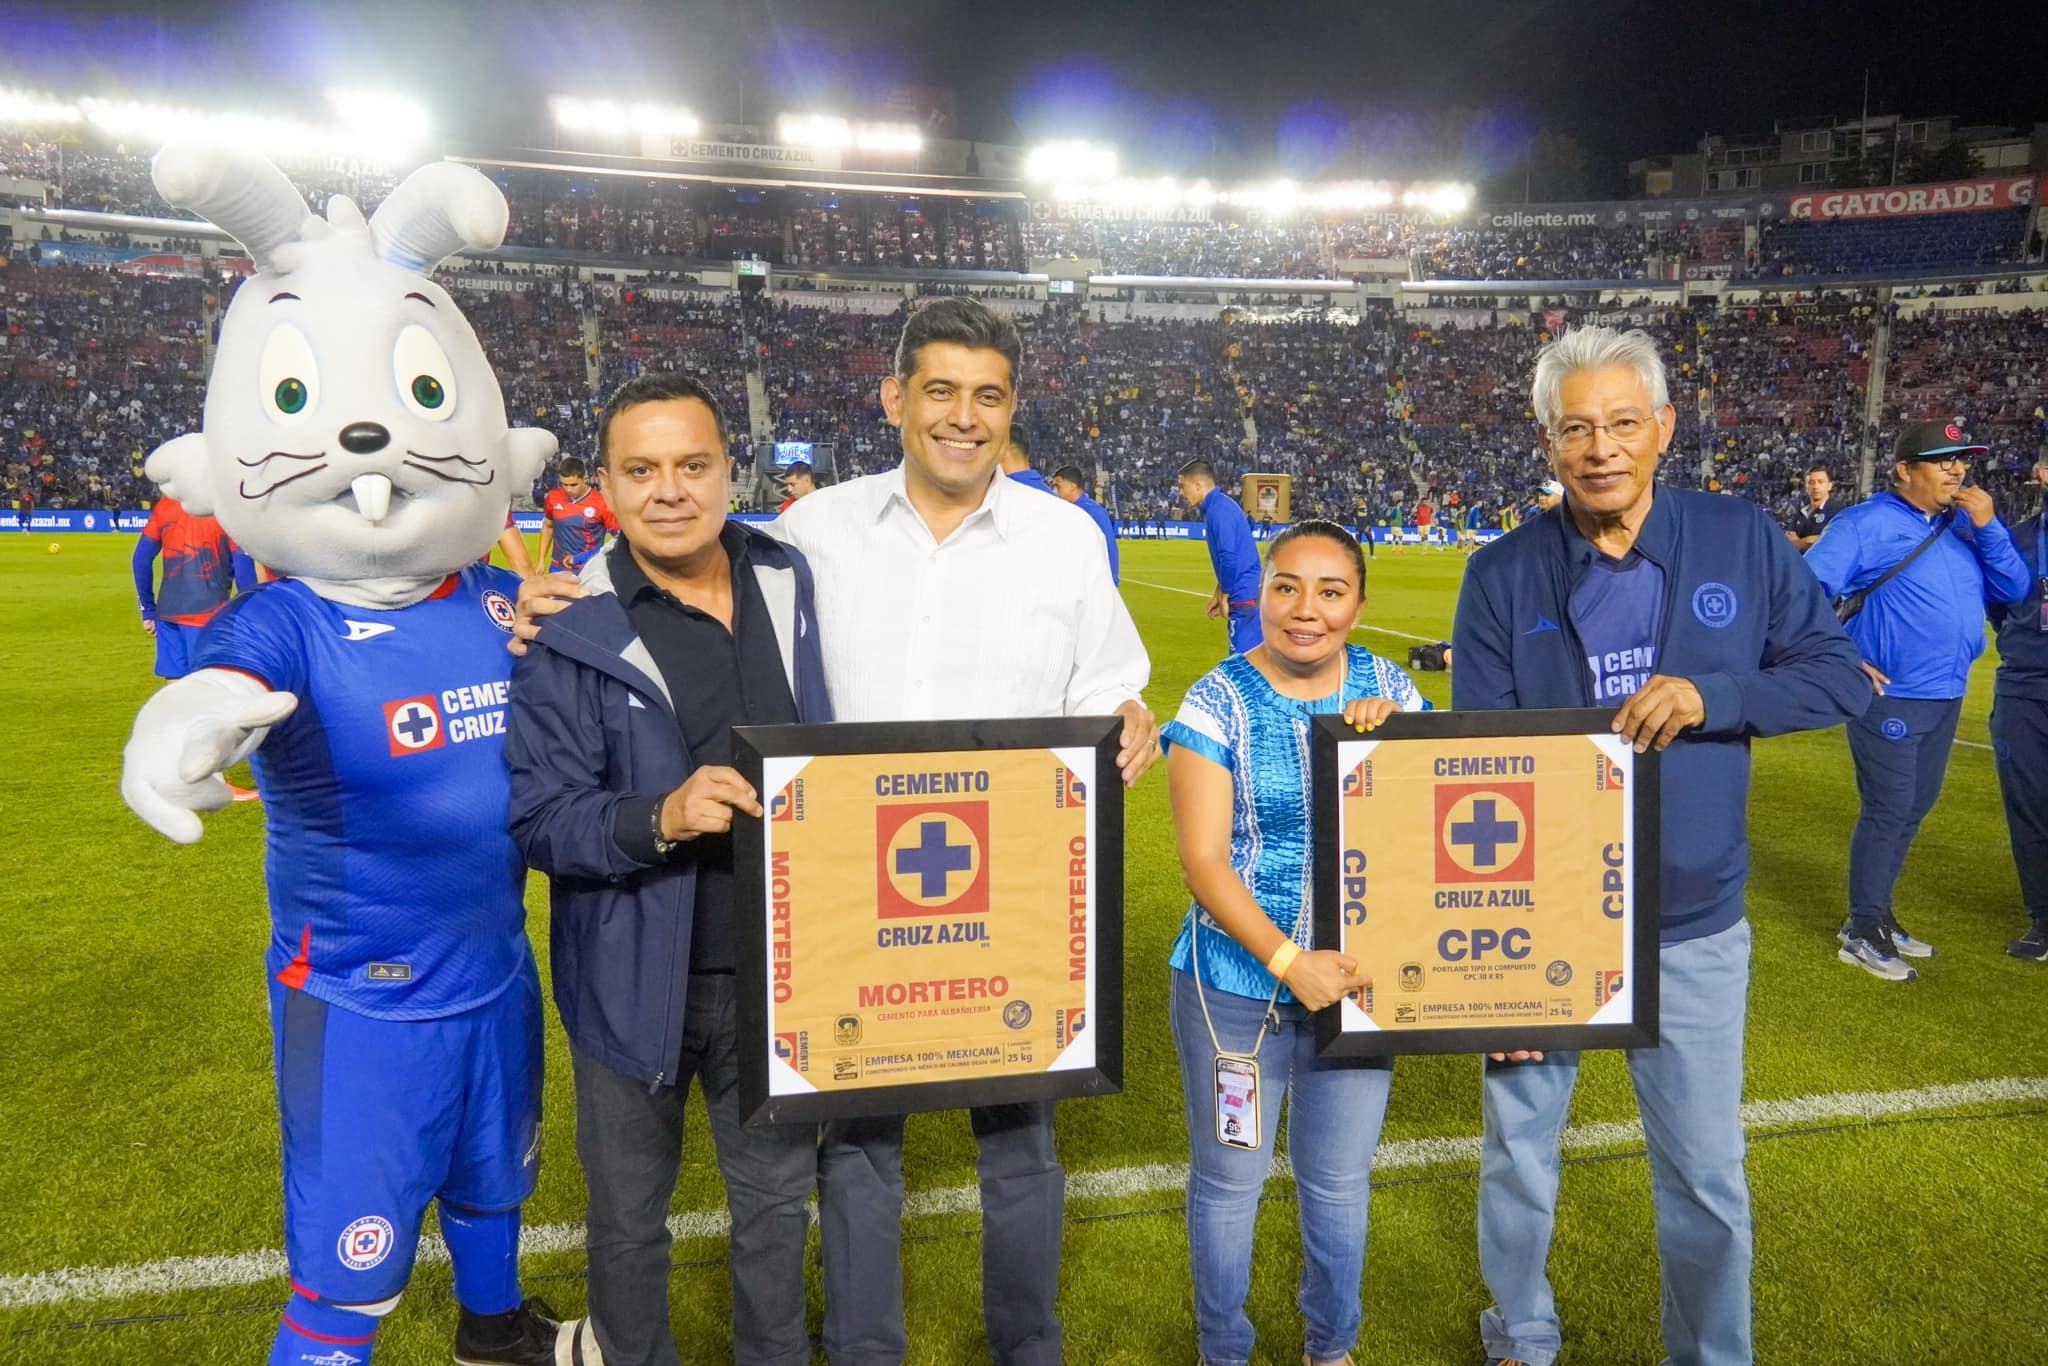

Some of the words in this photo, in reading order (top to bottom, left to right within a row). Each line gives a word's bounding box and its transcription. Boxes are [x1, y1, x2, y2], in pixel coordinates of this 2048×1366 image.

[690, 142, 750, 160] CEMENTO
[752, 147, 783, 161] CRUZ
[785, 149, 815, 163] AZUL
[1821, 183, 1996, 217] GATORADE
[1492, 211, 1597, 228] caliente.mx
[457, 278, 512, 292] CEMENTO
[1604, 646, 1656, 673] CEM
[448, 710, 507, 744] CRUZ
[1364, 759, 1373, 797] CEMENTO
[1434, 755, 1535, 777] CEMENTO
[1596, 753, 1604, 791] CEMENTO
[875, 770, 989, 797] CEMENTO
[1055, 767, 1064, 809] CEMENTO
[795, 778, 804, 822] CEMENTO
[1344, 848, 1367, 926] CPC
[1602, 842, 1624, 920] CPC
[1069, 835, 1087, 982] MORTERO
[1434, 890, 1484, 909] CRUZ
[1487, 889, 1535, 907] AZUL
[771, 851, 793, 1004] MORTERO
[877, 925, 933, 948] CRUZ
[936, 921, 990, 944] AZUL
[1437, 927, 1532, 962] CPC
[1432, 965, 1469, 974] PORTLAND
[1470, 965, 1486, 973] TIPO
[1494, 963, 1536, 972] COMPUESTO
[1463, 973, 1478, 981] CPC
[858, 975, 1009, 1008] MORTERO
[1366, 982, 1374, 1013] EMENTO
[1594, 970, 1603, 1008] CEMENTO
[877, 1010, 915, 1022] CEMENTO
[917, 1008, 939, 1018] PARA
[1423, 1003, 1465, 1013] EMPRESA
[1468, 1002, 1492, 1011] 100%
[1494, 1001, 1543, 1011] MEXICANA
[1549, 1007, 1560, 1016] 25
[1561, 1007, 1573, 1017] kg
[1056, 1009, 1065, 1050] CEMENTO
[799, 1030, 809, 1073] CEMENTO
[865, 1055, 914, 1066] EMPRESA
[916, 1051, 944, 1062] 100%
[946, 1046, 1000, 1060] MEXICANA
[1007, 1053, 1018, 1062] 25
[1020, 1052, 1032, 1063] kg
